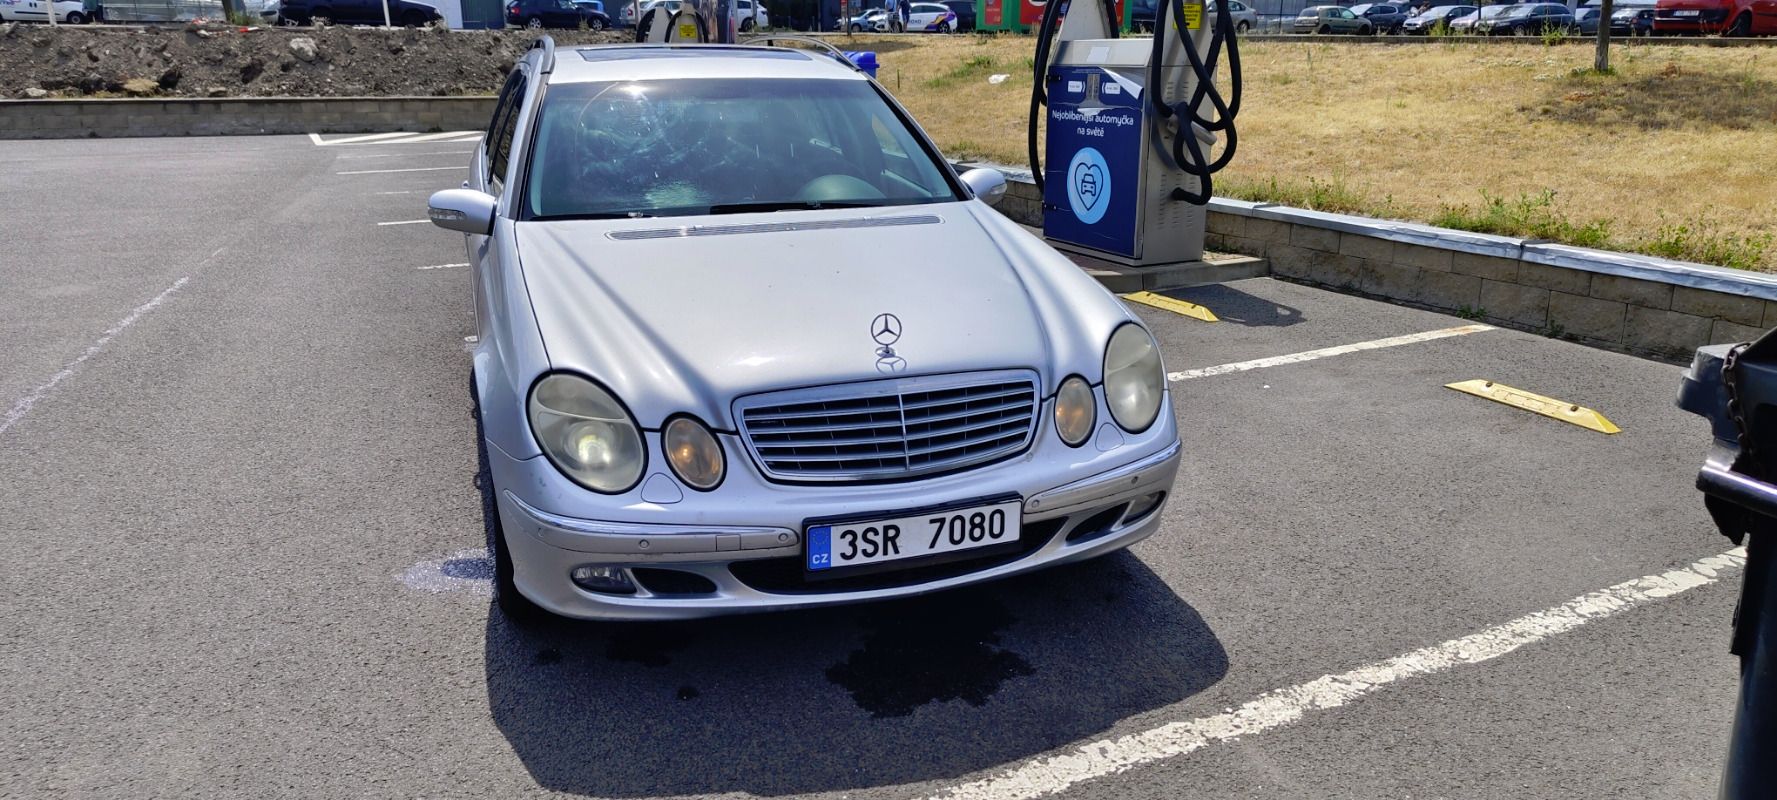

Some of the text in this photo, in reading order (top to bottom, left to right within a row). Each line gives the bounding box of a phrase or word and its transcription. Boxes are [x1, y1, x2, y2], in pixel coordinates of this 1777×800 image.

[1094, 114, 1134, 127] automyčka
[1077, 127, 1104, 137] na světě
[839, 508, 1006, 561] 3SR 7080
[812, 553, 829, 565] CZ
